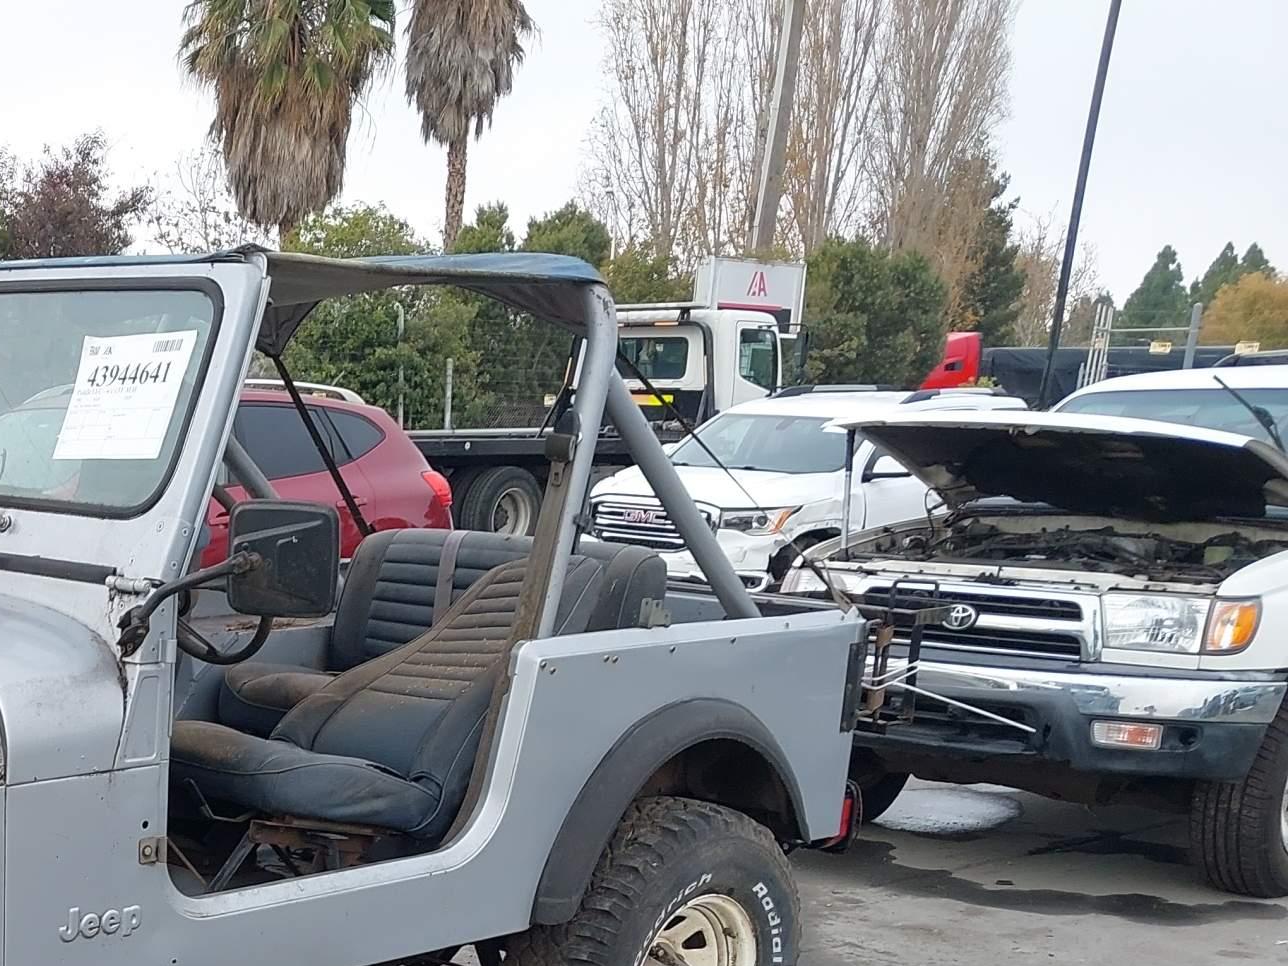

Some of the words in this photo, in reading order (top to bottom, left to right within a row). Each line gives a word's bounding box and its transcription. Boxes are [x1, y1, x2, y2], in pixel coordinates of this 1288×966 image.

[87, 361, 172, 387] 43944641
[58, 904, 142, 943] Jeep
[752, 882, 784, 963] Radial
